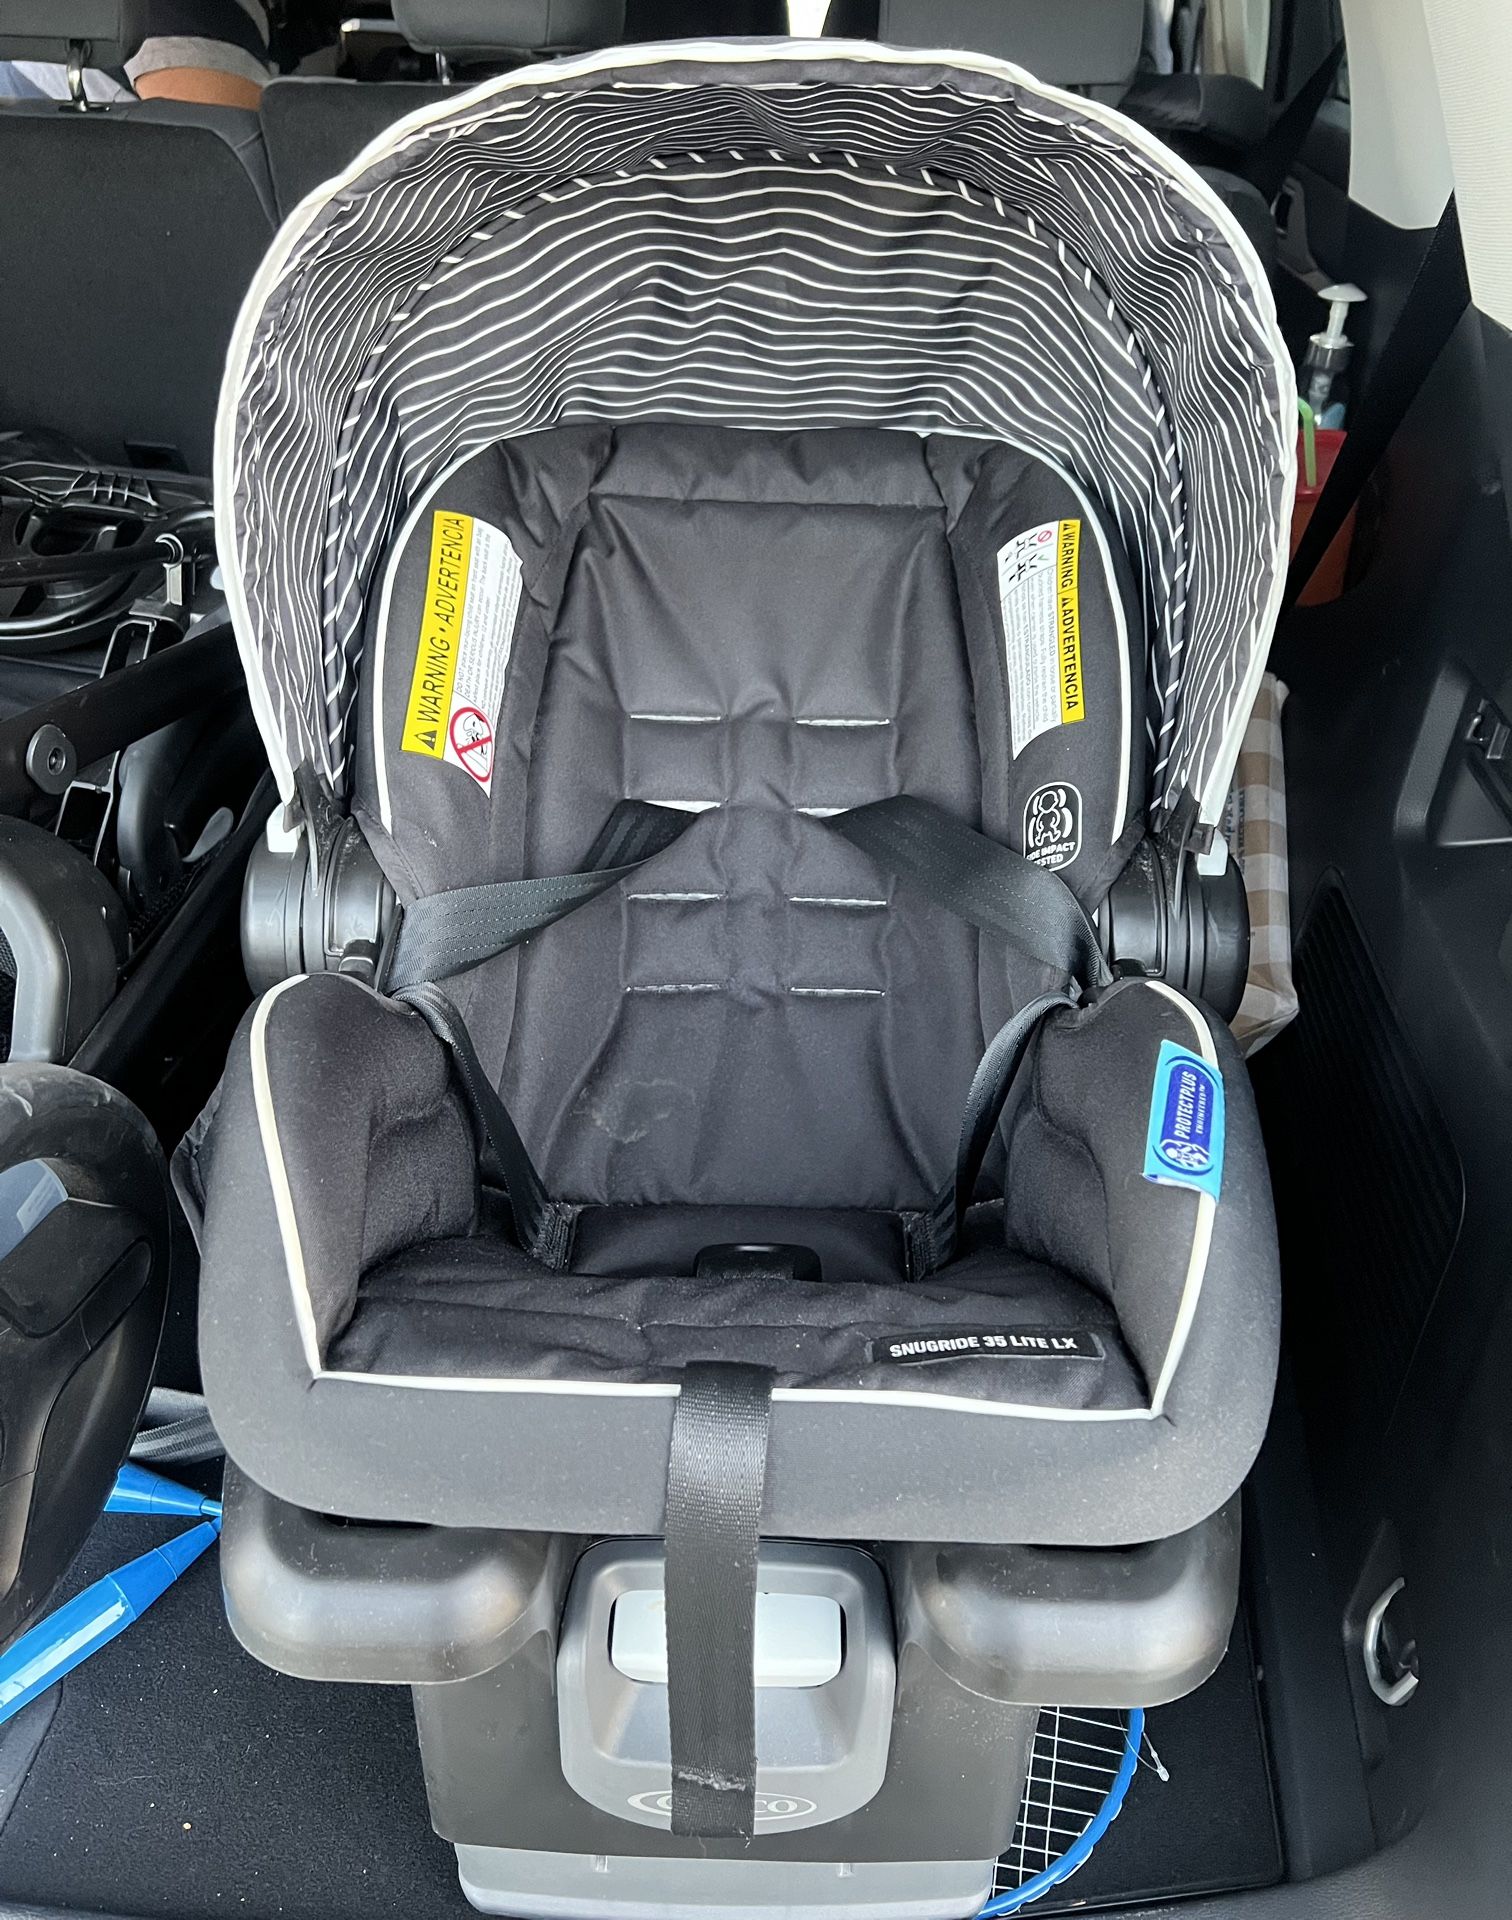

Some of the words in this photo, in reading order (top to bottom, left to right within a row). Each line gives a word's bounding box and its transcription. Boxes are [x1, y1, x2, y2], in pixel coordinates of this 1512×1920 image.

[1061, 532, 1076, 588] WARNING
[416, 636, 451, 723] WARNING
[434, 518, 465, 627] ADVERTENCIA
[1047, 610, 1056, 656] STRANGLED
[1061, 608, 1079, 711] ADVERTENCIA
[1041, 841, 1076, 857] IMPACT
[1173, 1070, 1198, 1140] PROTECTPLUS
[889, 1336, 980, 1358] SNUGRIDE
[982, 1335, 1008, 1348] 35
[1009, 1335, 1049, 1349] LITE
[1050, 1337, 1079, 1350] LX
